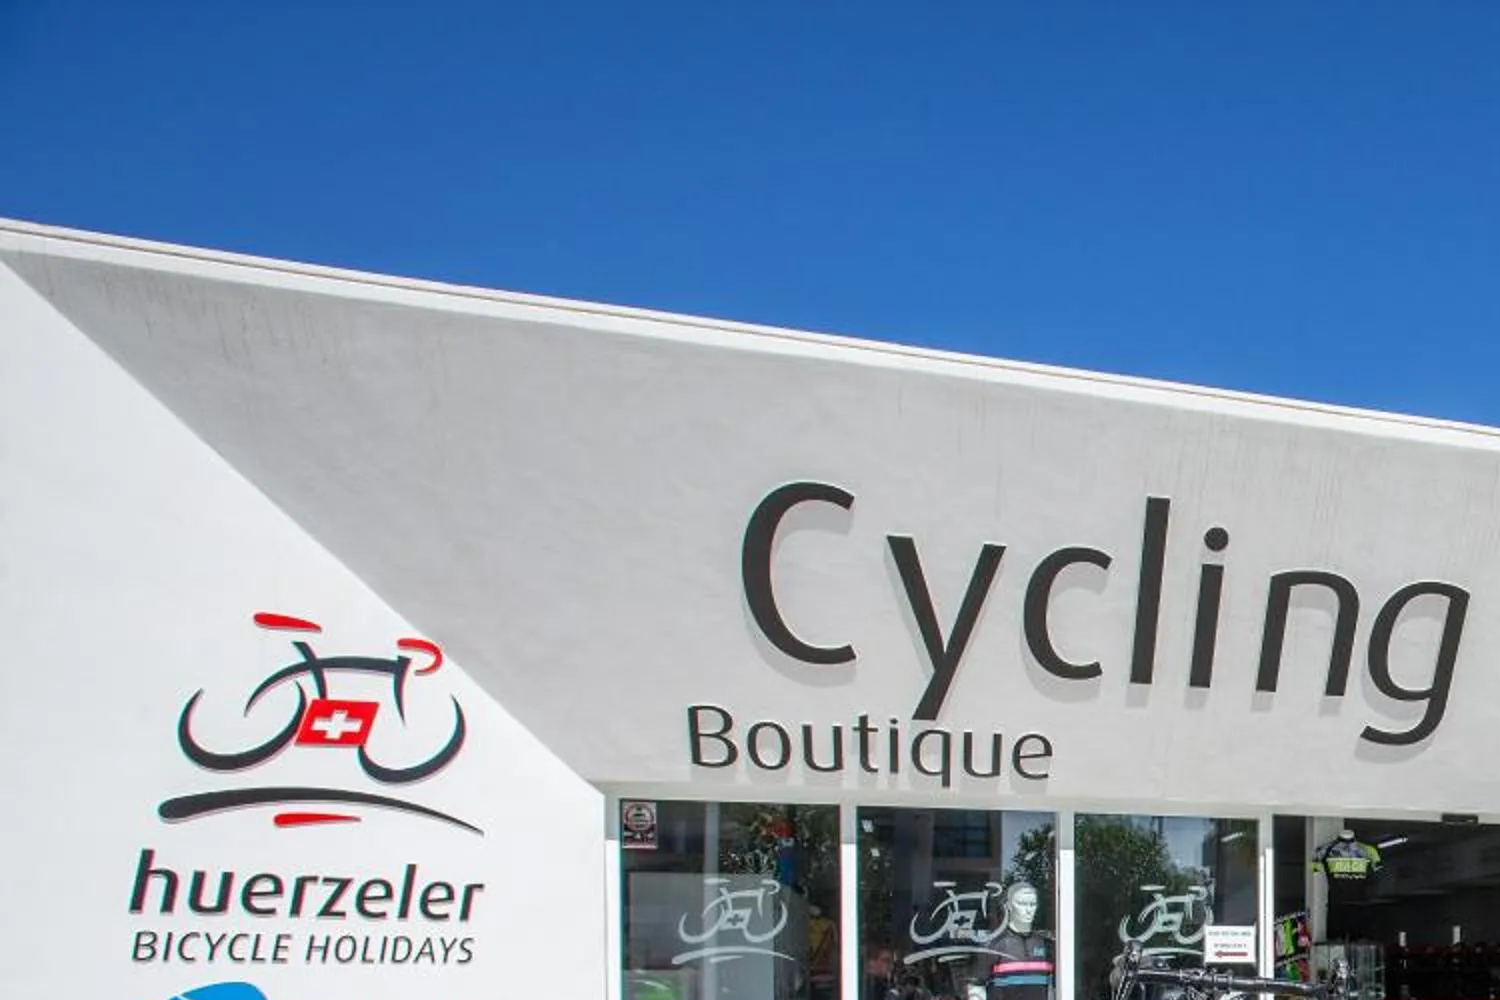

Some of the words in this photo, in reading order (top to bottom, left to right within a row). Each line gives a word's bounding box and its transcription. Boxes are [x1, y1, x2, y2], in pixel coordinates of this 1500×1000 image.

[742, 481, 1471, 746] Cycling
[687, 705, 1055, 788] Boutique
[129, 848, 486, 922] huerzeler
[131, 931, 293, 963] BICYCLE
[305, 935, 475, 965] HOLIDAYS
